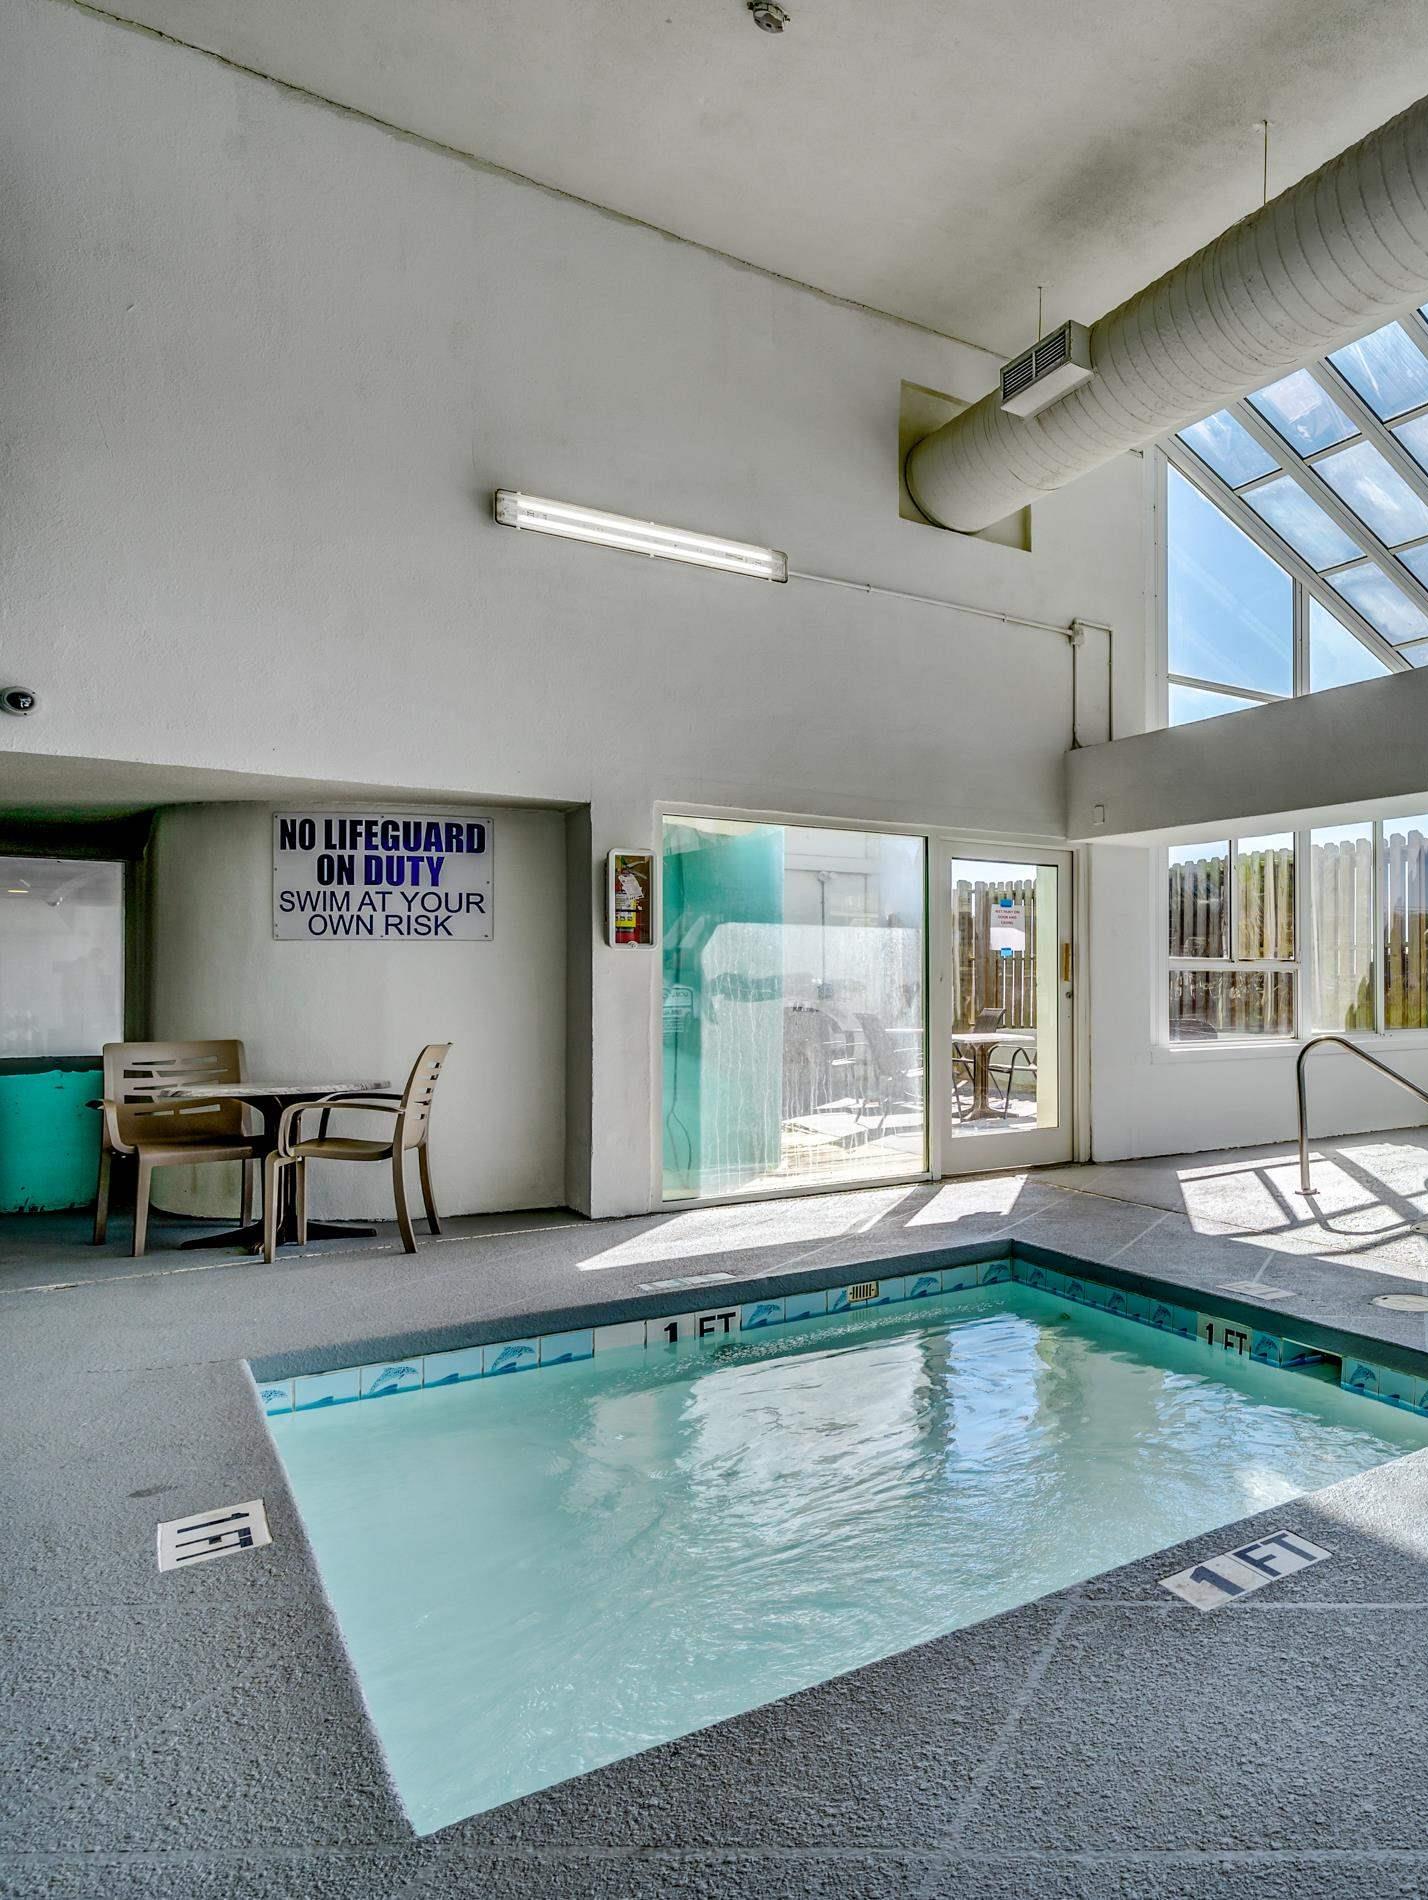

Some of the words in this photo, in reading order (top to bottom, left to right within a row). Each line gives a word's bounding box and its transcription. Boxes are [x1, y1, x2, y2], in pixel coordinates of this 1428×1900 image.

[280, 818, 316, 850] NO
[324, 819, 486, 854] LIFEGUARD
[317, 854, 355, 886] ON
[364, 854, 445, 887] DUTY
[279, 890, 351, 913] SWIM
[357, 891, 393, 913] AT
[400, 891, 486, 914] YOUR
[308, 914, 374, 936] OWN
[384, 914, 454, 937] RISK
[664, 1322, 678, 1343] 1
[699, 1311, 736, 1338] FT
[1206, 1323, 1214, 1345] 1
[1224, 1328, 1248, 1355] FT
[1189, 1565, 1246, 1597] 1
[1232, 1532, 1318, 1578] FT
